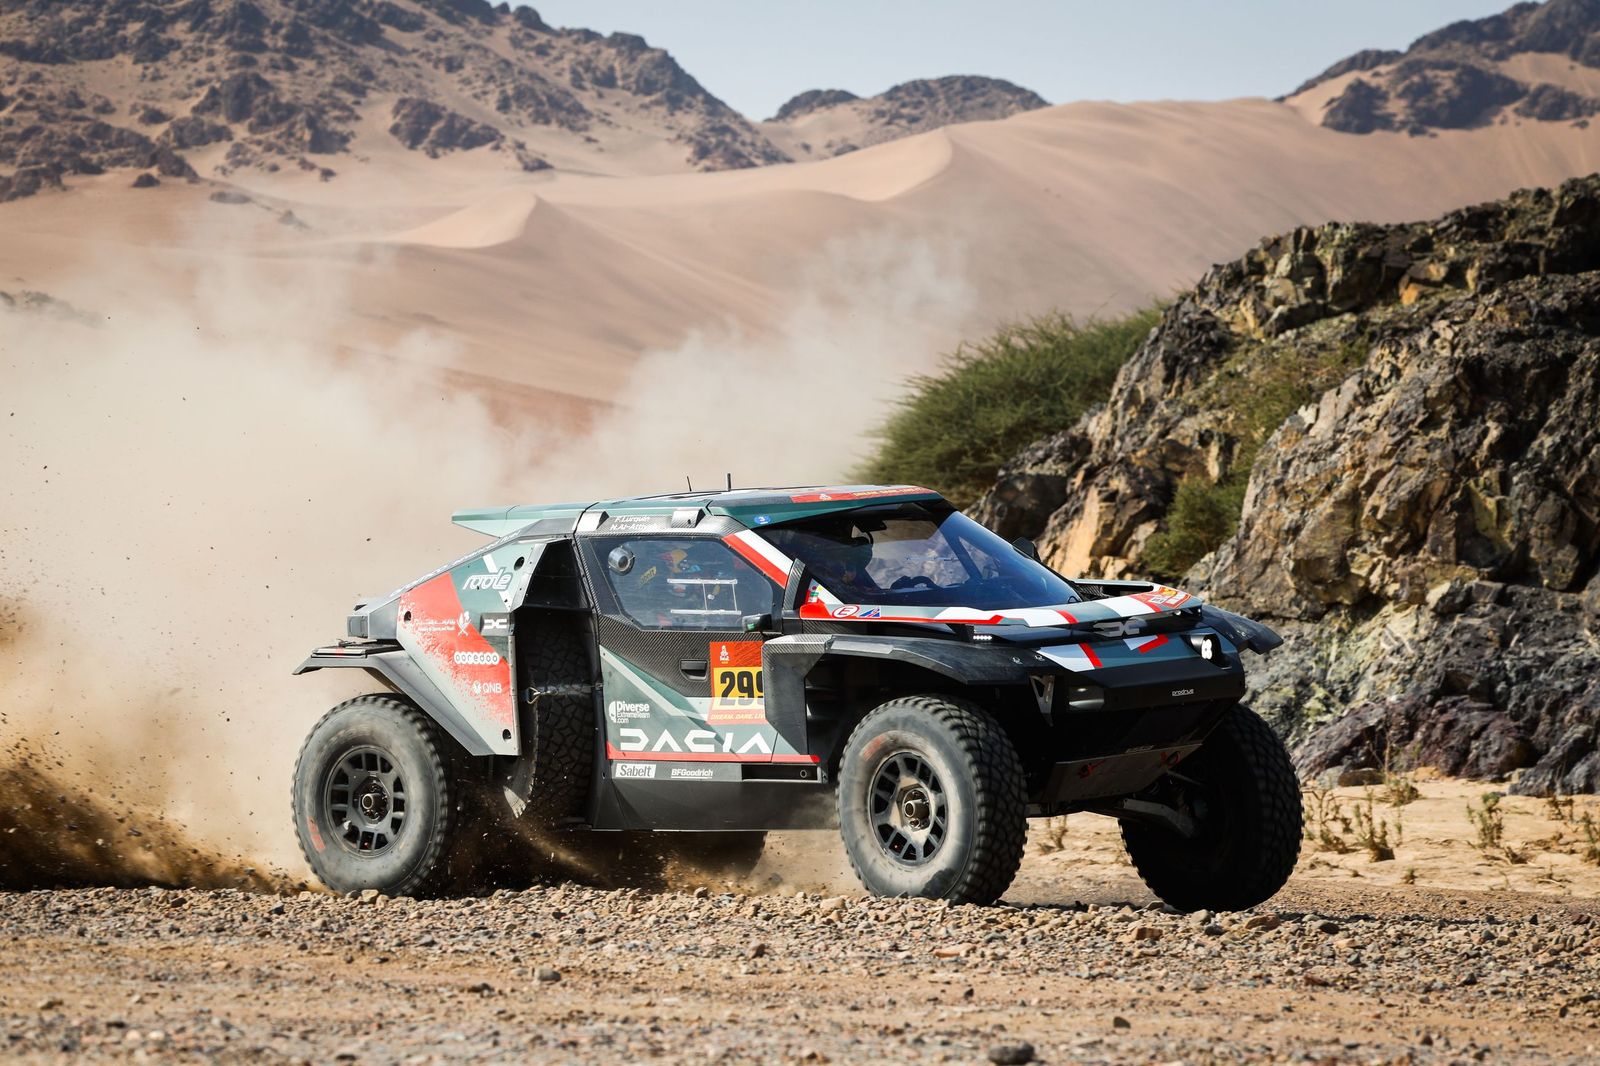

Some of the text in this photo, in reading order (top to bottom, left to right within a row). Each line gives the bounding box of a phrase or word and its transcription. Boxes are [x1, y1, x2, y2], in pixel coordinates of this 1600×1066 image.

[454, 652, 499, 664] ooredoo
[482, 682, 502, 694] QNB
[616, 700, 650, 712] Diverse
[619, 727, 772, 753] DACIA
[620, 764, 652, 777] Sabelt
[671, 768, 713, 777] BFGoodrich
